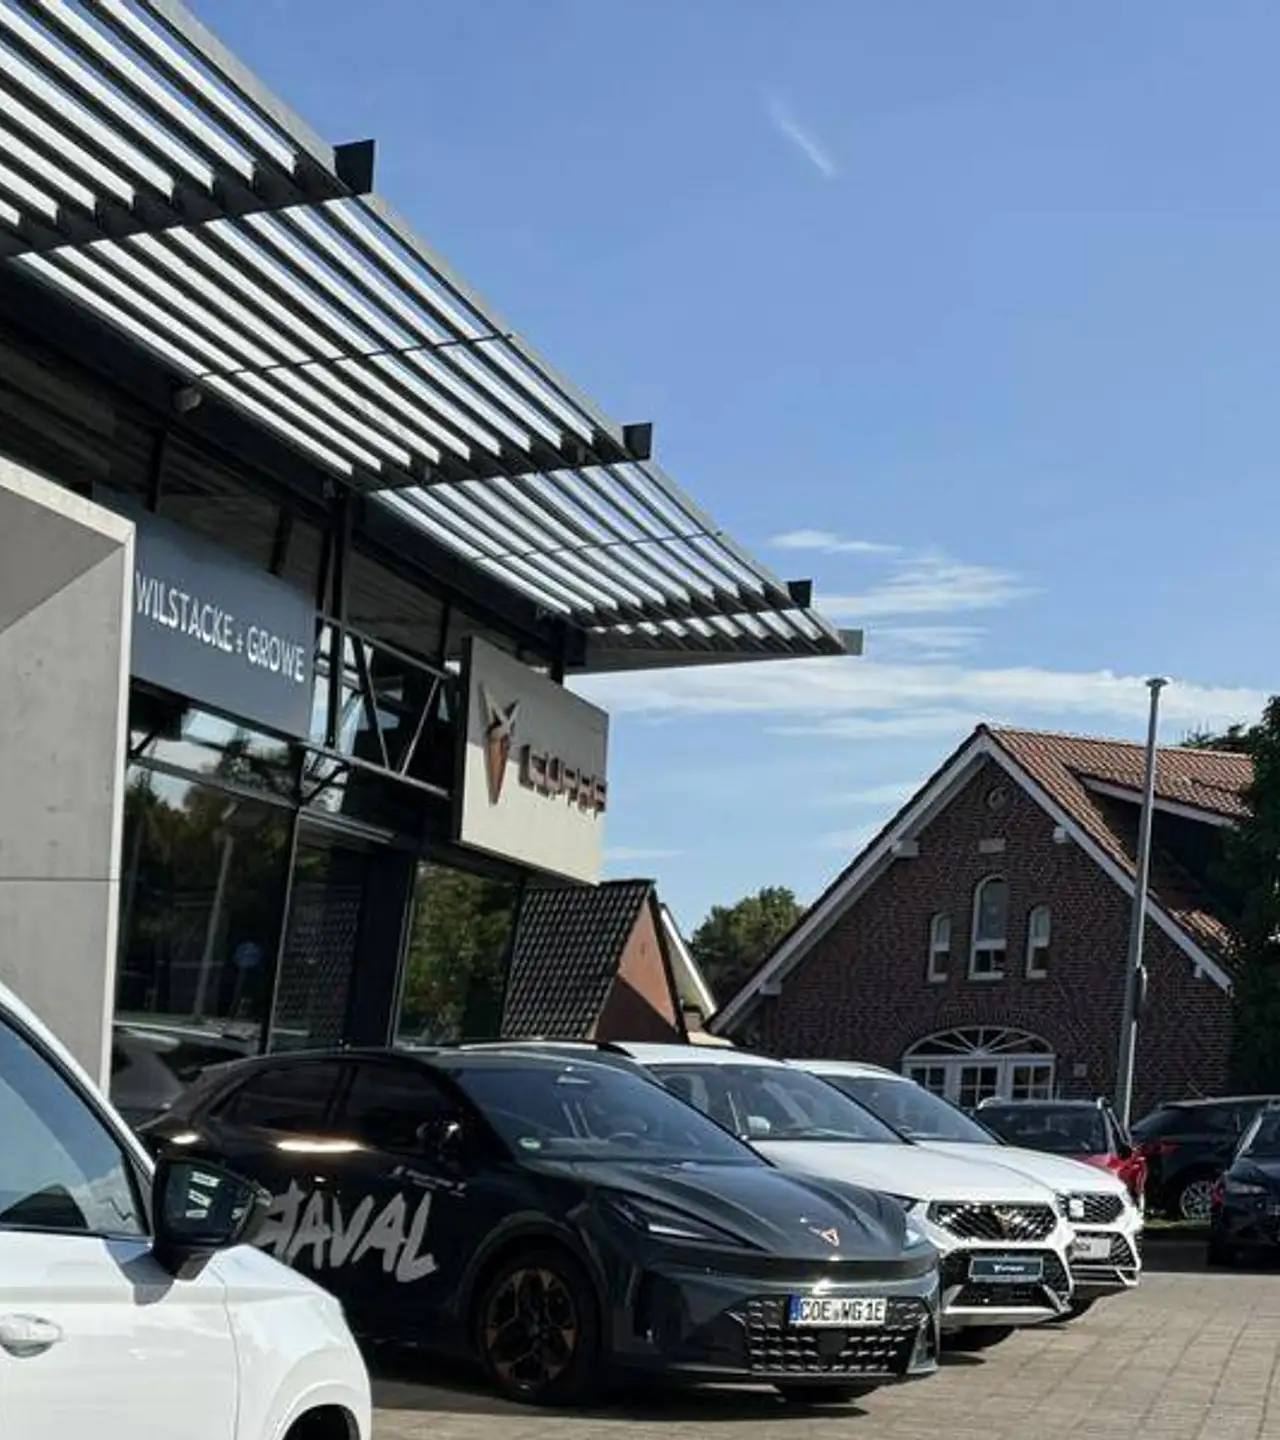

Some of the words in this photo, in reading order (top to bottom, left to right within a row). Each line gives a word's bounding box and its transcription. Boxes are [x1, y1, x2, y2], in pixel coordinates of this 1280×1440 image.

[135, 570, 234, 653] WILSTACKE
[246, 624, 305, 683] GROWE
[801, 1300, 832, 1321] COE
